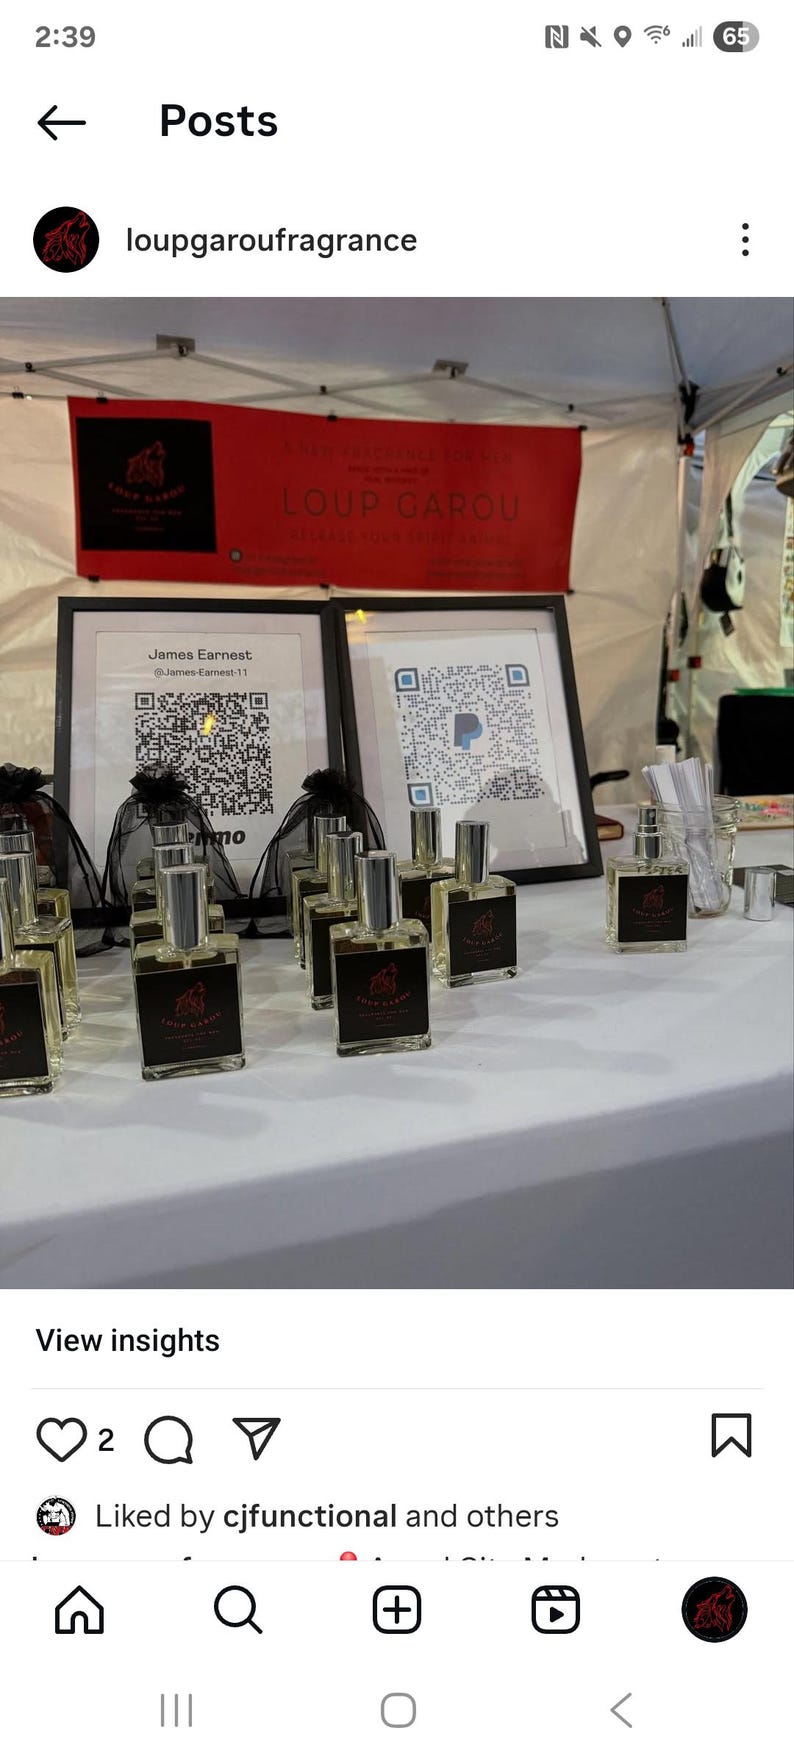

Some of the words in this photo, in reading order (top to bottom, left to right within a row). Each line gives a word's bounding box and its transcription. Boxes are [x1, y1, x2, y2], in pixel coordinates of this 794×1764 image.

[282, 487, 379, 518] LOUP
[397, 491, 519, 522] GAROU
[148, 649, 194, 660] James
[197, 649, 253, 661] Earnest
[154, 668, 248, 679] @James-Earnest-11
[356, 995, 380, 1006] LOUP
[382, 991, 411, 1007] GAROU
[161, 1017, 187, 1029] LOUP
[189, 1011, 222, 1029] GAROU
